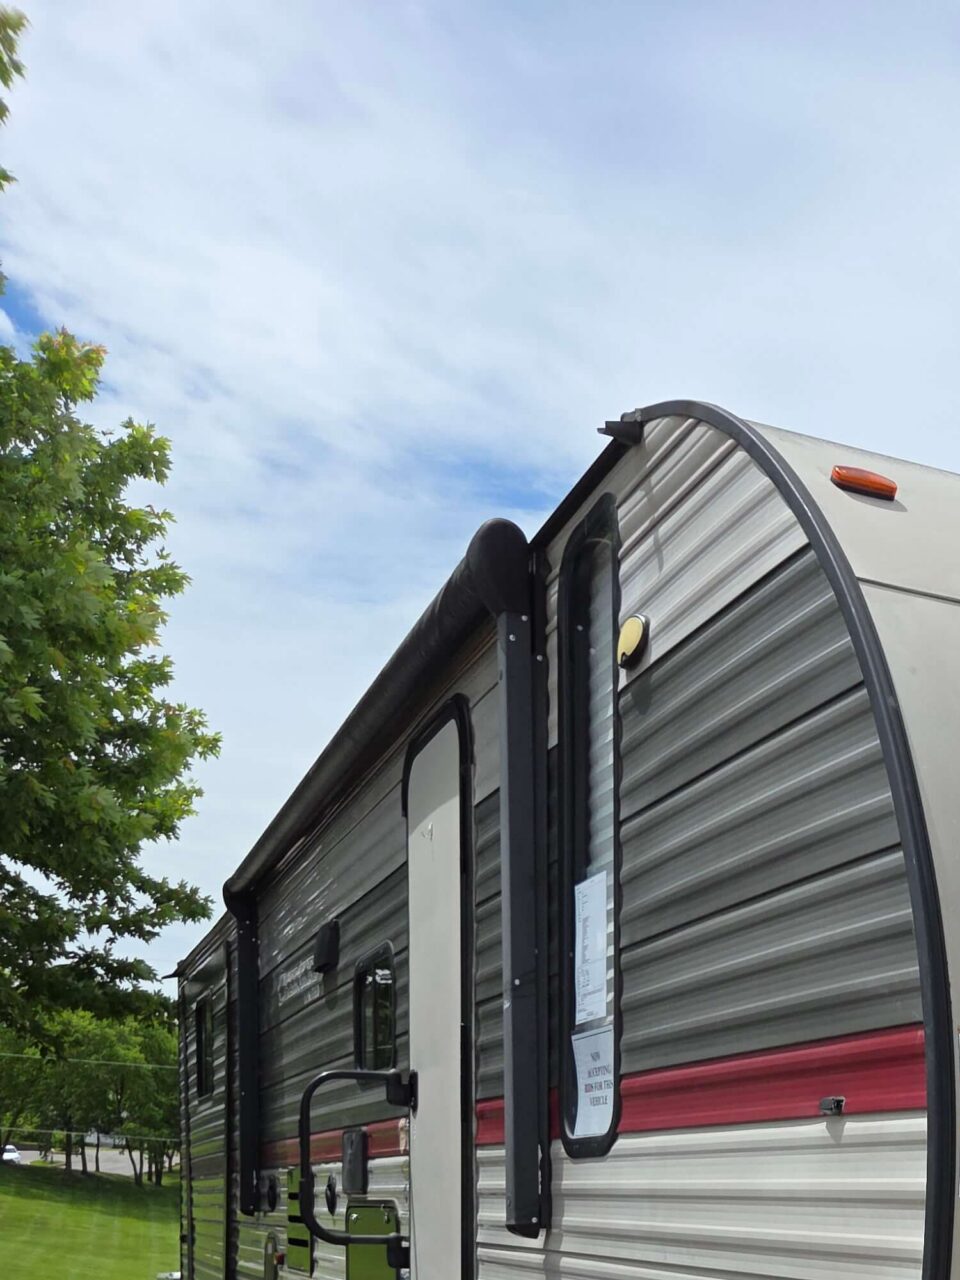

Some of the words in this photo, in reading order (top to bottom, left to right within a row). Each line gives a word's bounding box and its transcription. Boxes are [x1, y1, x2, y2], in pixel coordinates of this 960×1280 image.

[587, 1063, 612, 1078] ACCEPTING
[594, 1081, 603, 1091] FOR
[589, 1094, 608, 1107] VEHICLE
